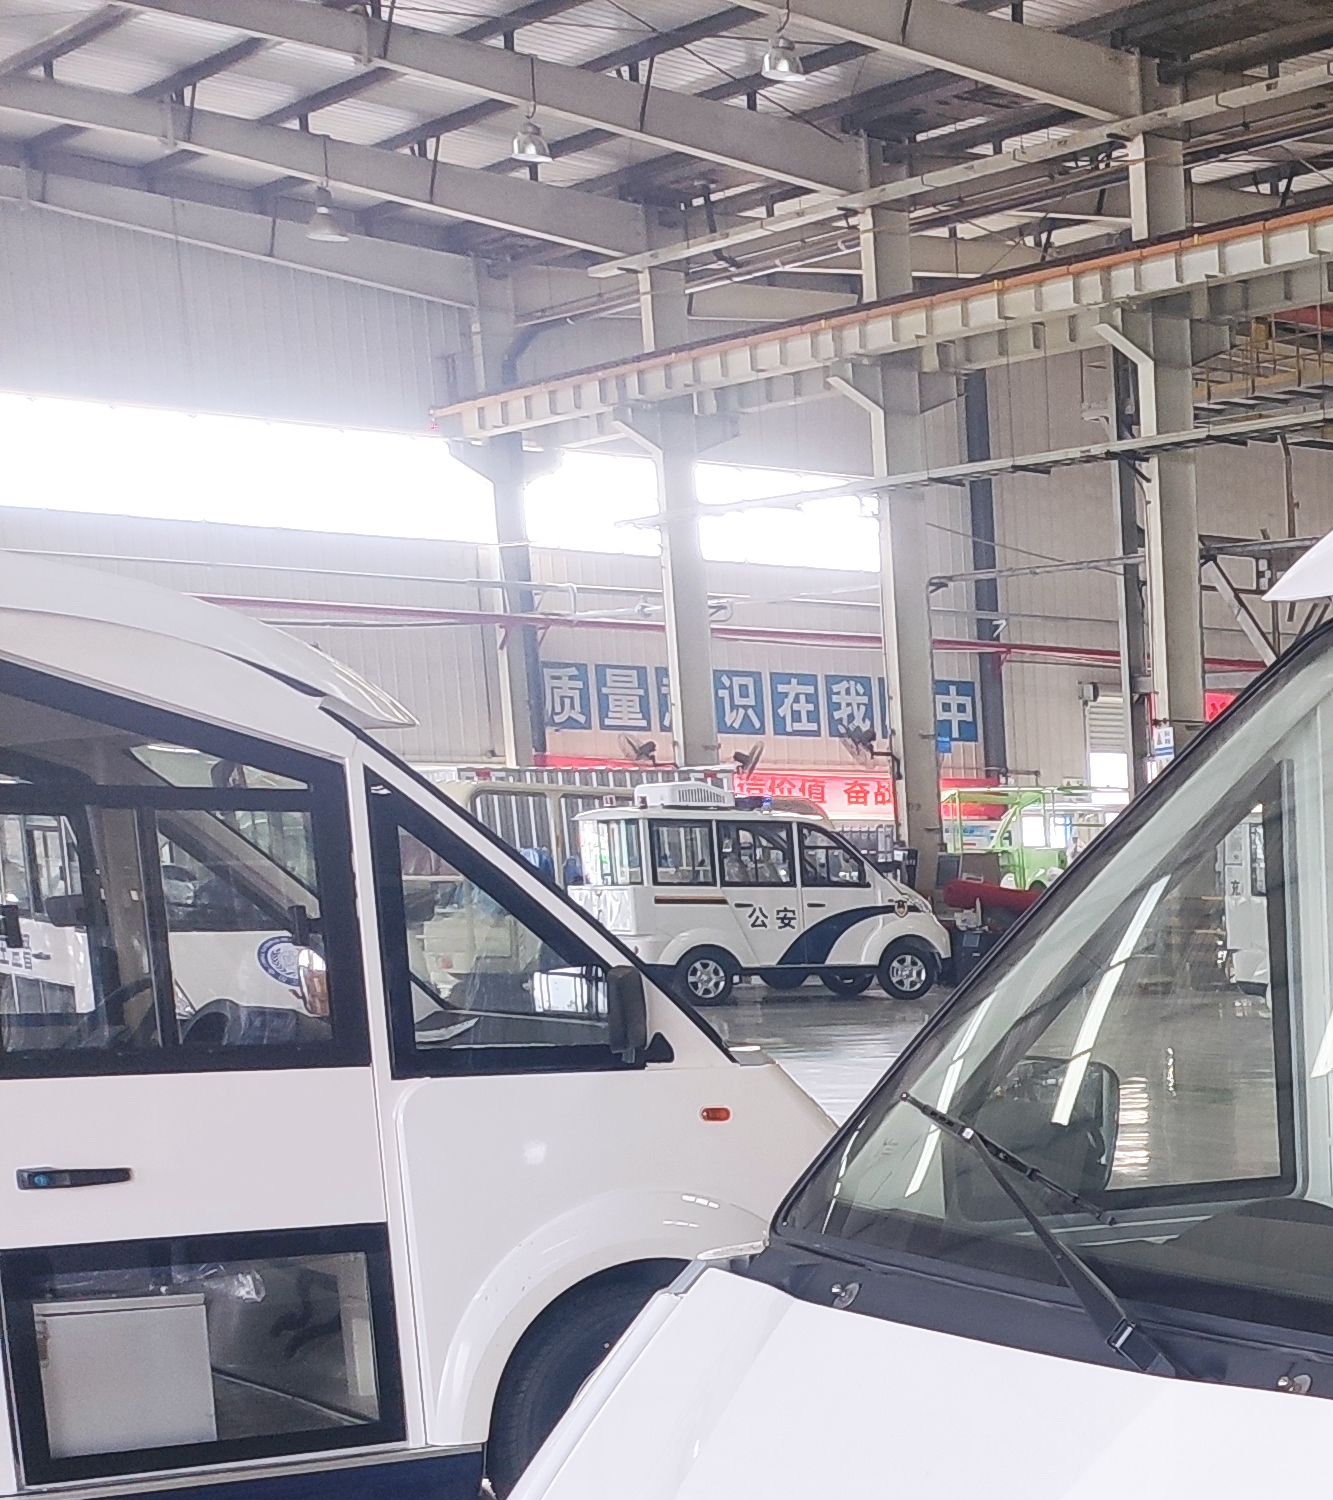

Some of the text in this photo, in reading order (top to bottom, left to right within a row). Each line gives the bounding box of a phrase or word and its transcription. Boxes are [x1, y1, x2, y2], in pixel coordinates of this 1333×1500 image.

[543, 666, 973, 739] 质量识在我中
[748, 906, 797, 930] 公安
